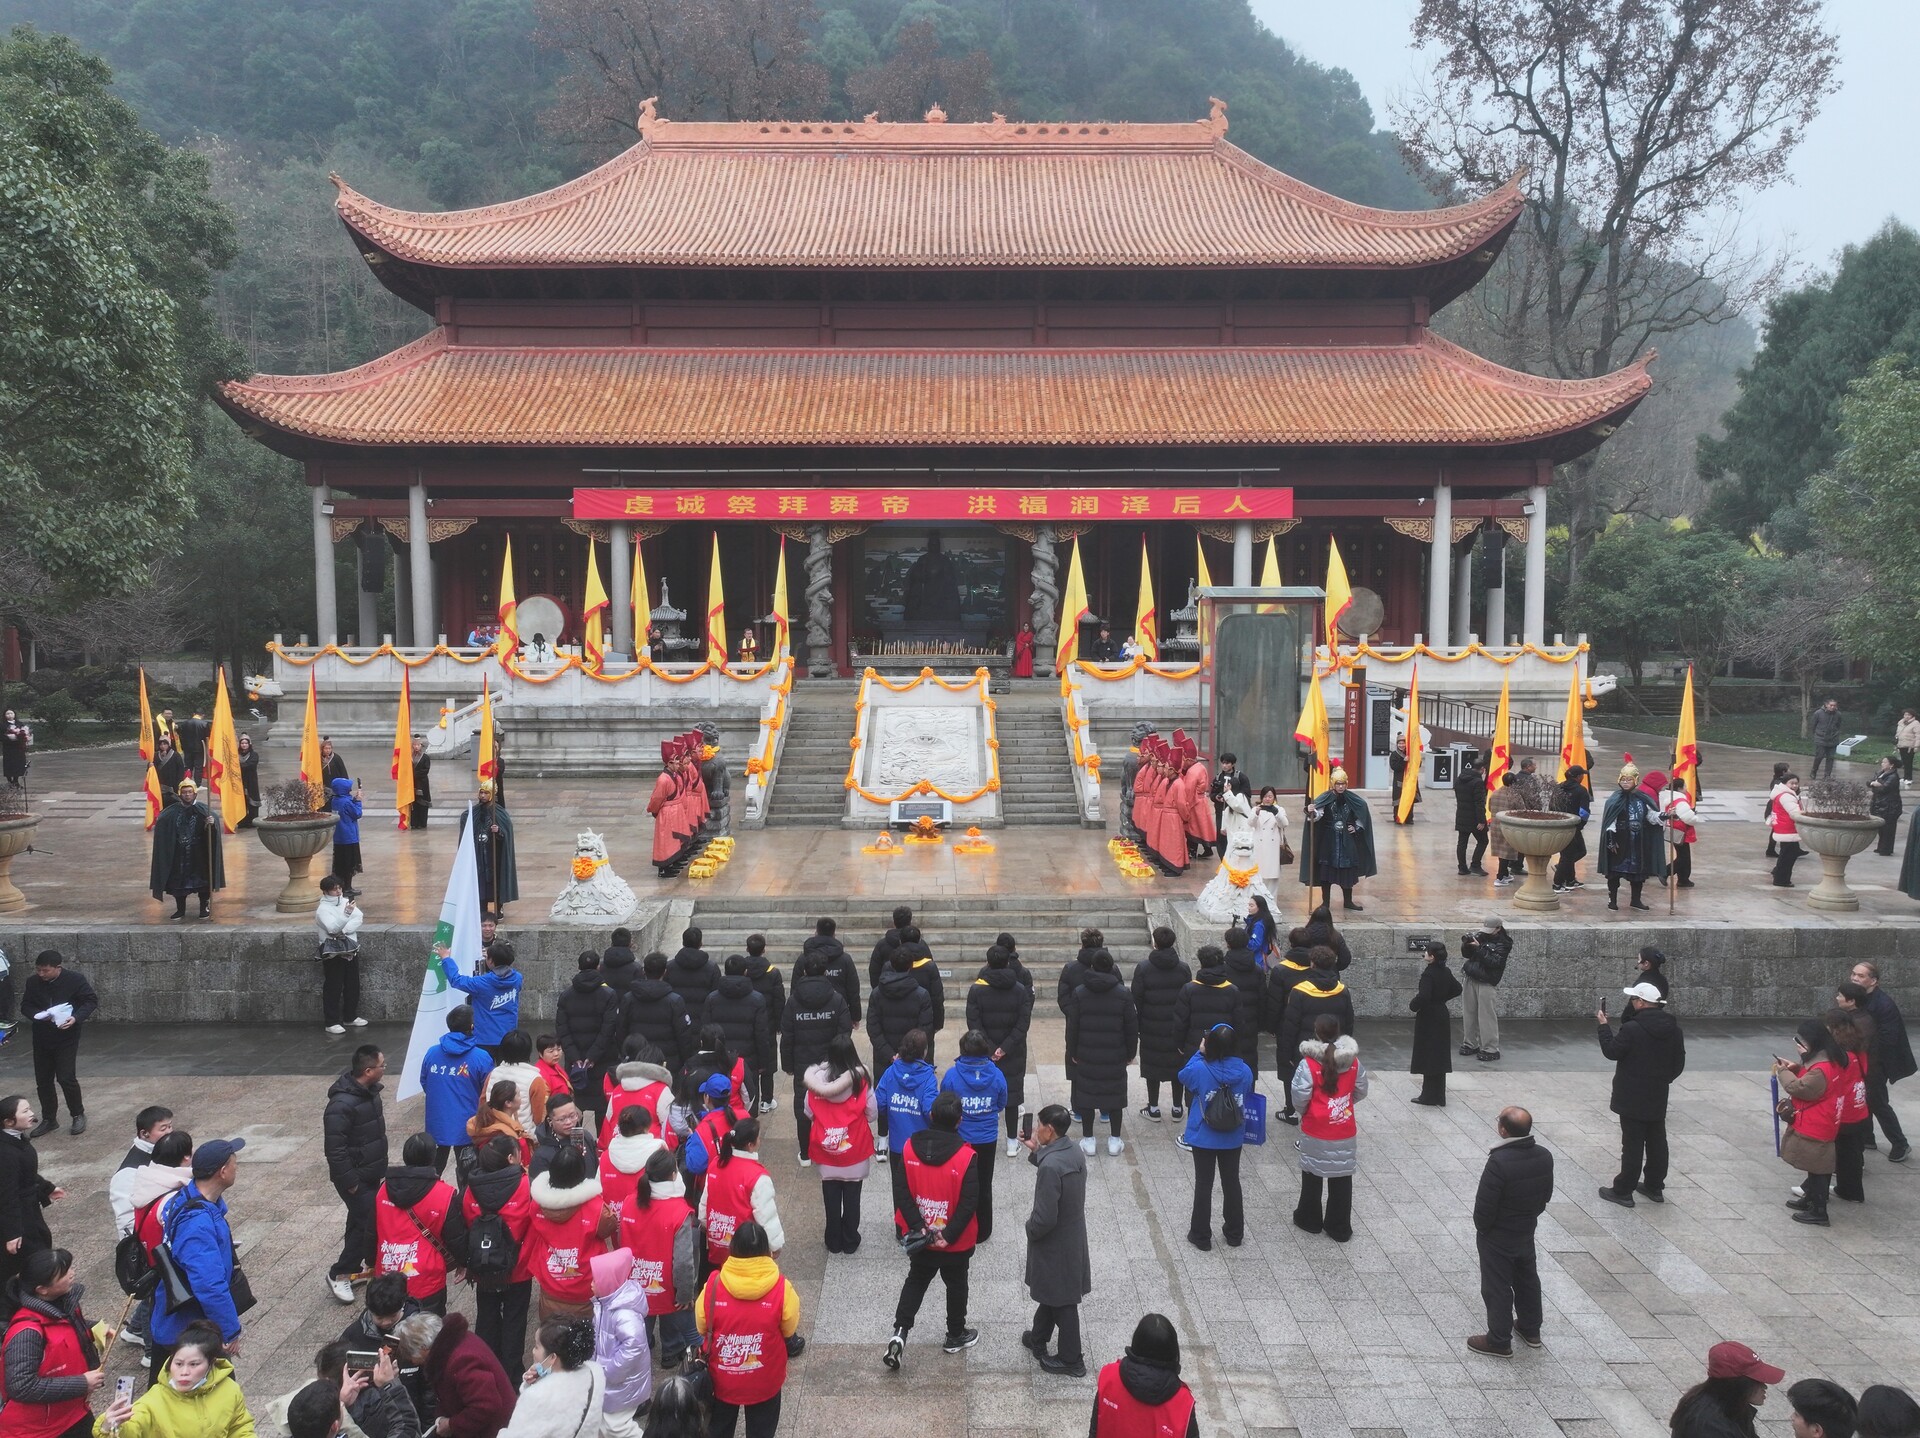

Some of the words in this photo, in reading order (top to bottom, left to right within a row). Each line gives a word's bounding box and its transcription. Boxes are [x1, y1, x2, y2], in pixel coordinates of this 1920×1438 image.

[624, 495, 909, 514] 虔诚祭拜舜帝
[967, 495, 1253, 514] 洪福润泽后人
[796, 1011, 832, 1021] KELME
